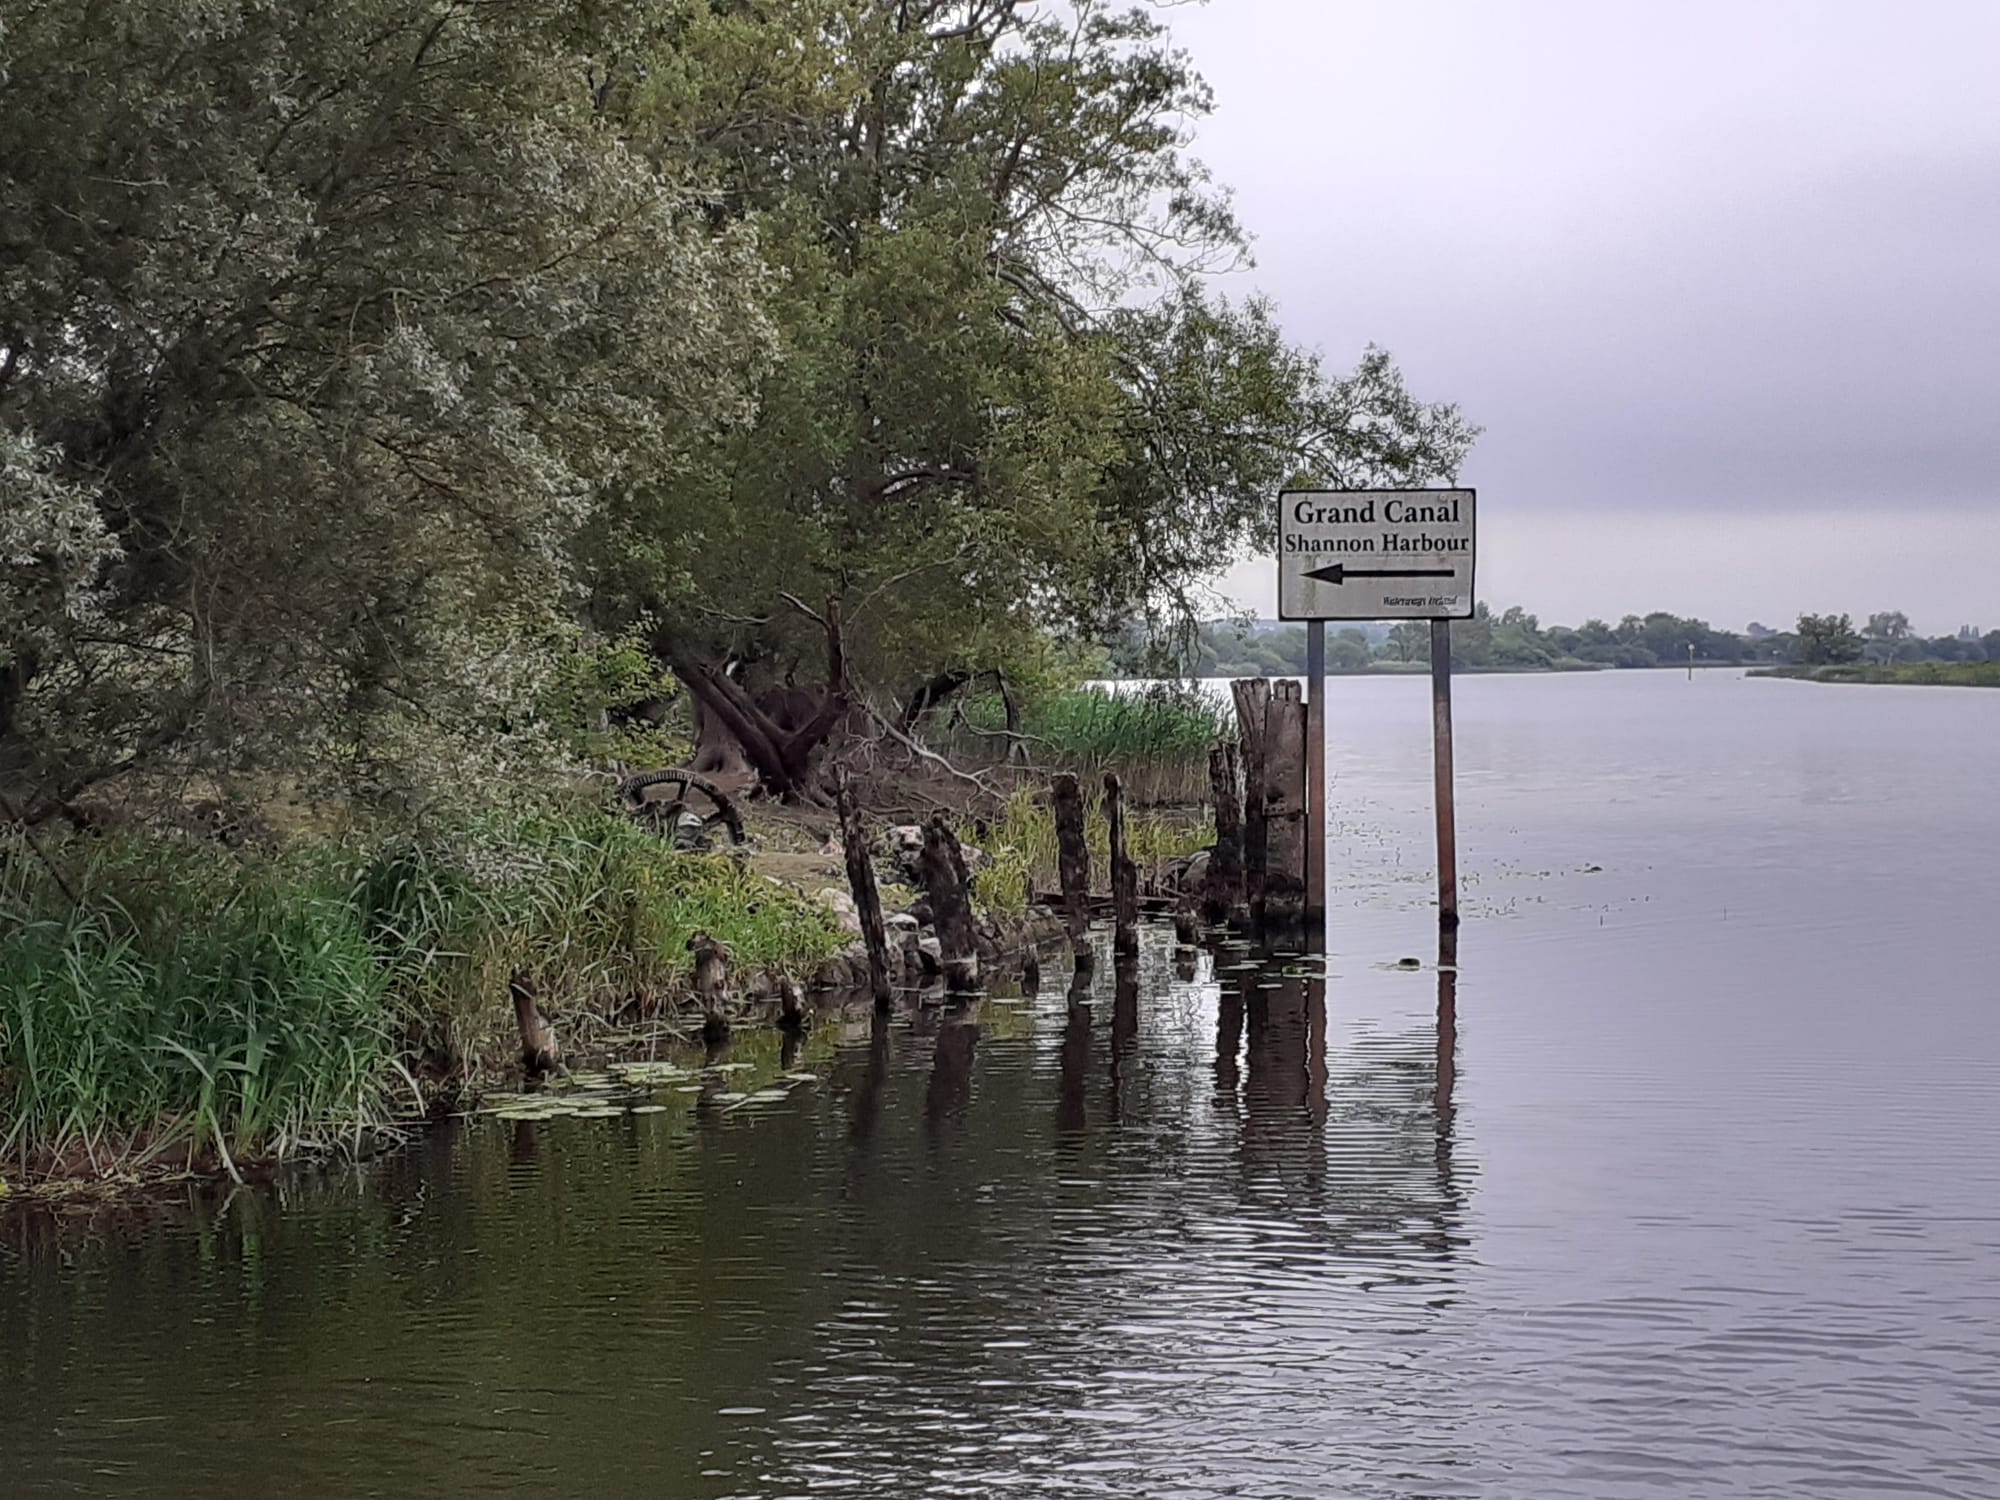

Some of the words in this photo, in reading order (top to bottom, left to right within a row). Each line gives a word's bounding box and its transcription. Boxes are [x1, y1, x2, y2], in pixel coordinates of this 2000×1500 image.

[1294, 500, 1376, 523] Grand
[1384, 499, 1460, 523] Canal
[1285, 534, 1374, 552] Shannon
[1382, 533, 1469, 551] Harbour
